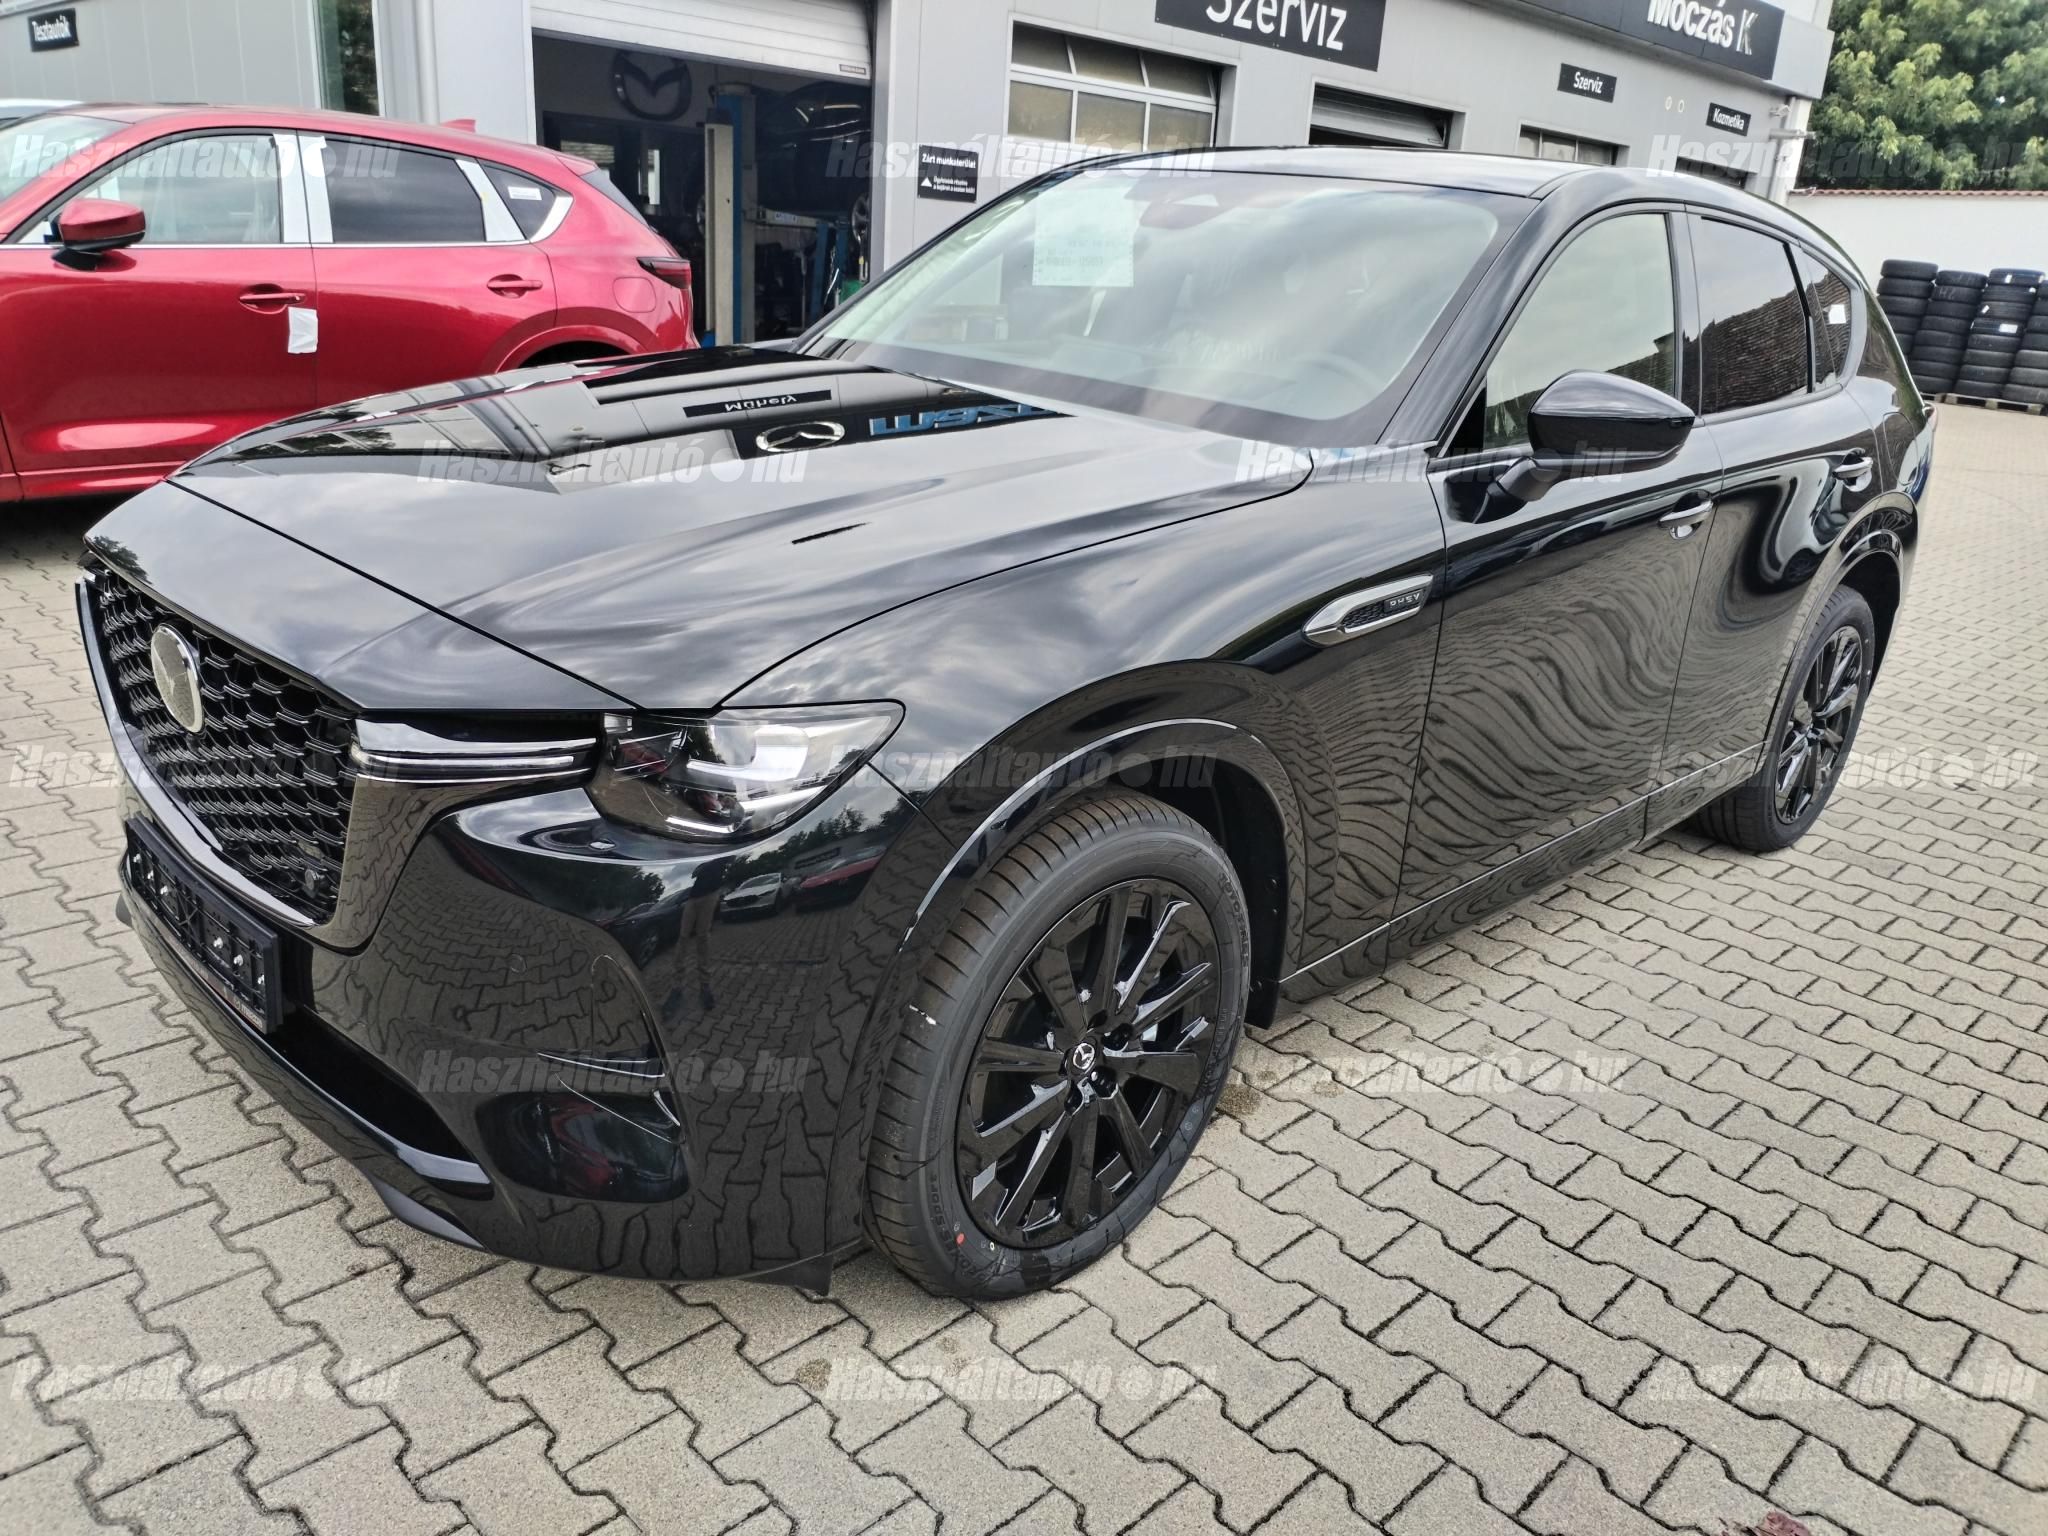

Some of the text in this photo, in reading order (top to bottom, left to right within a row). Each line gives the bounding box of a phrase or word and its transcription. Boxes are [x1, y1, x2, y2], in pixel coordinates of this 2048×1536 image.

[1206, 0, 1347, 51] Szerviz
[1573, 71, 1604, 94] Szerviz
[1712, 107, 1745, 130] Kozmetika
